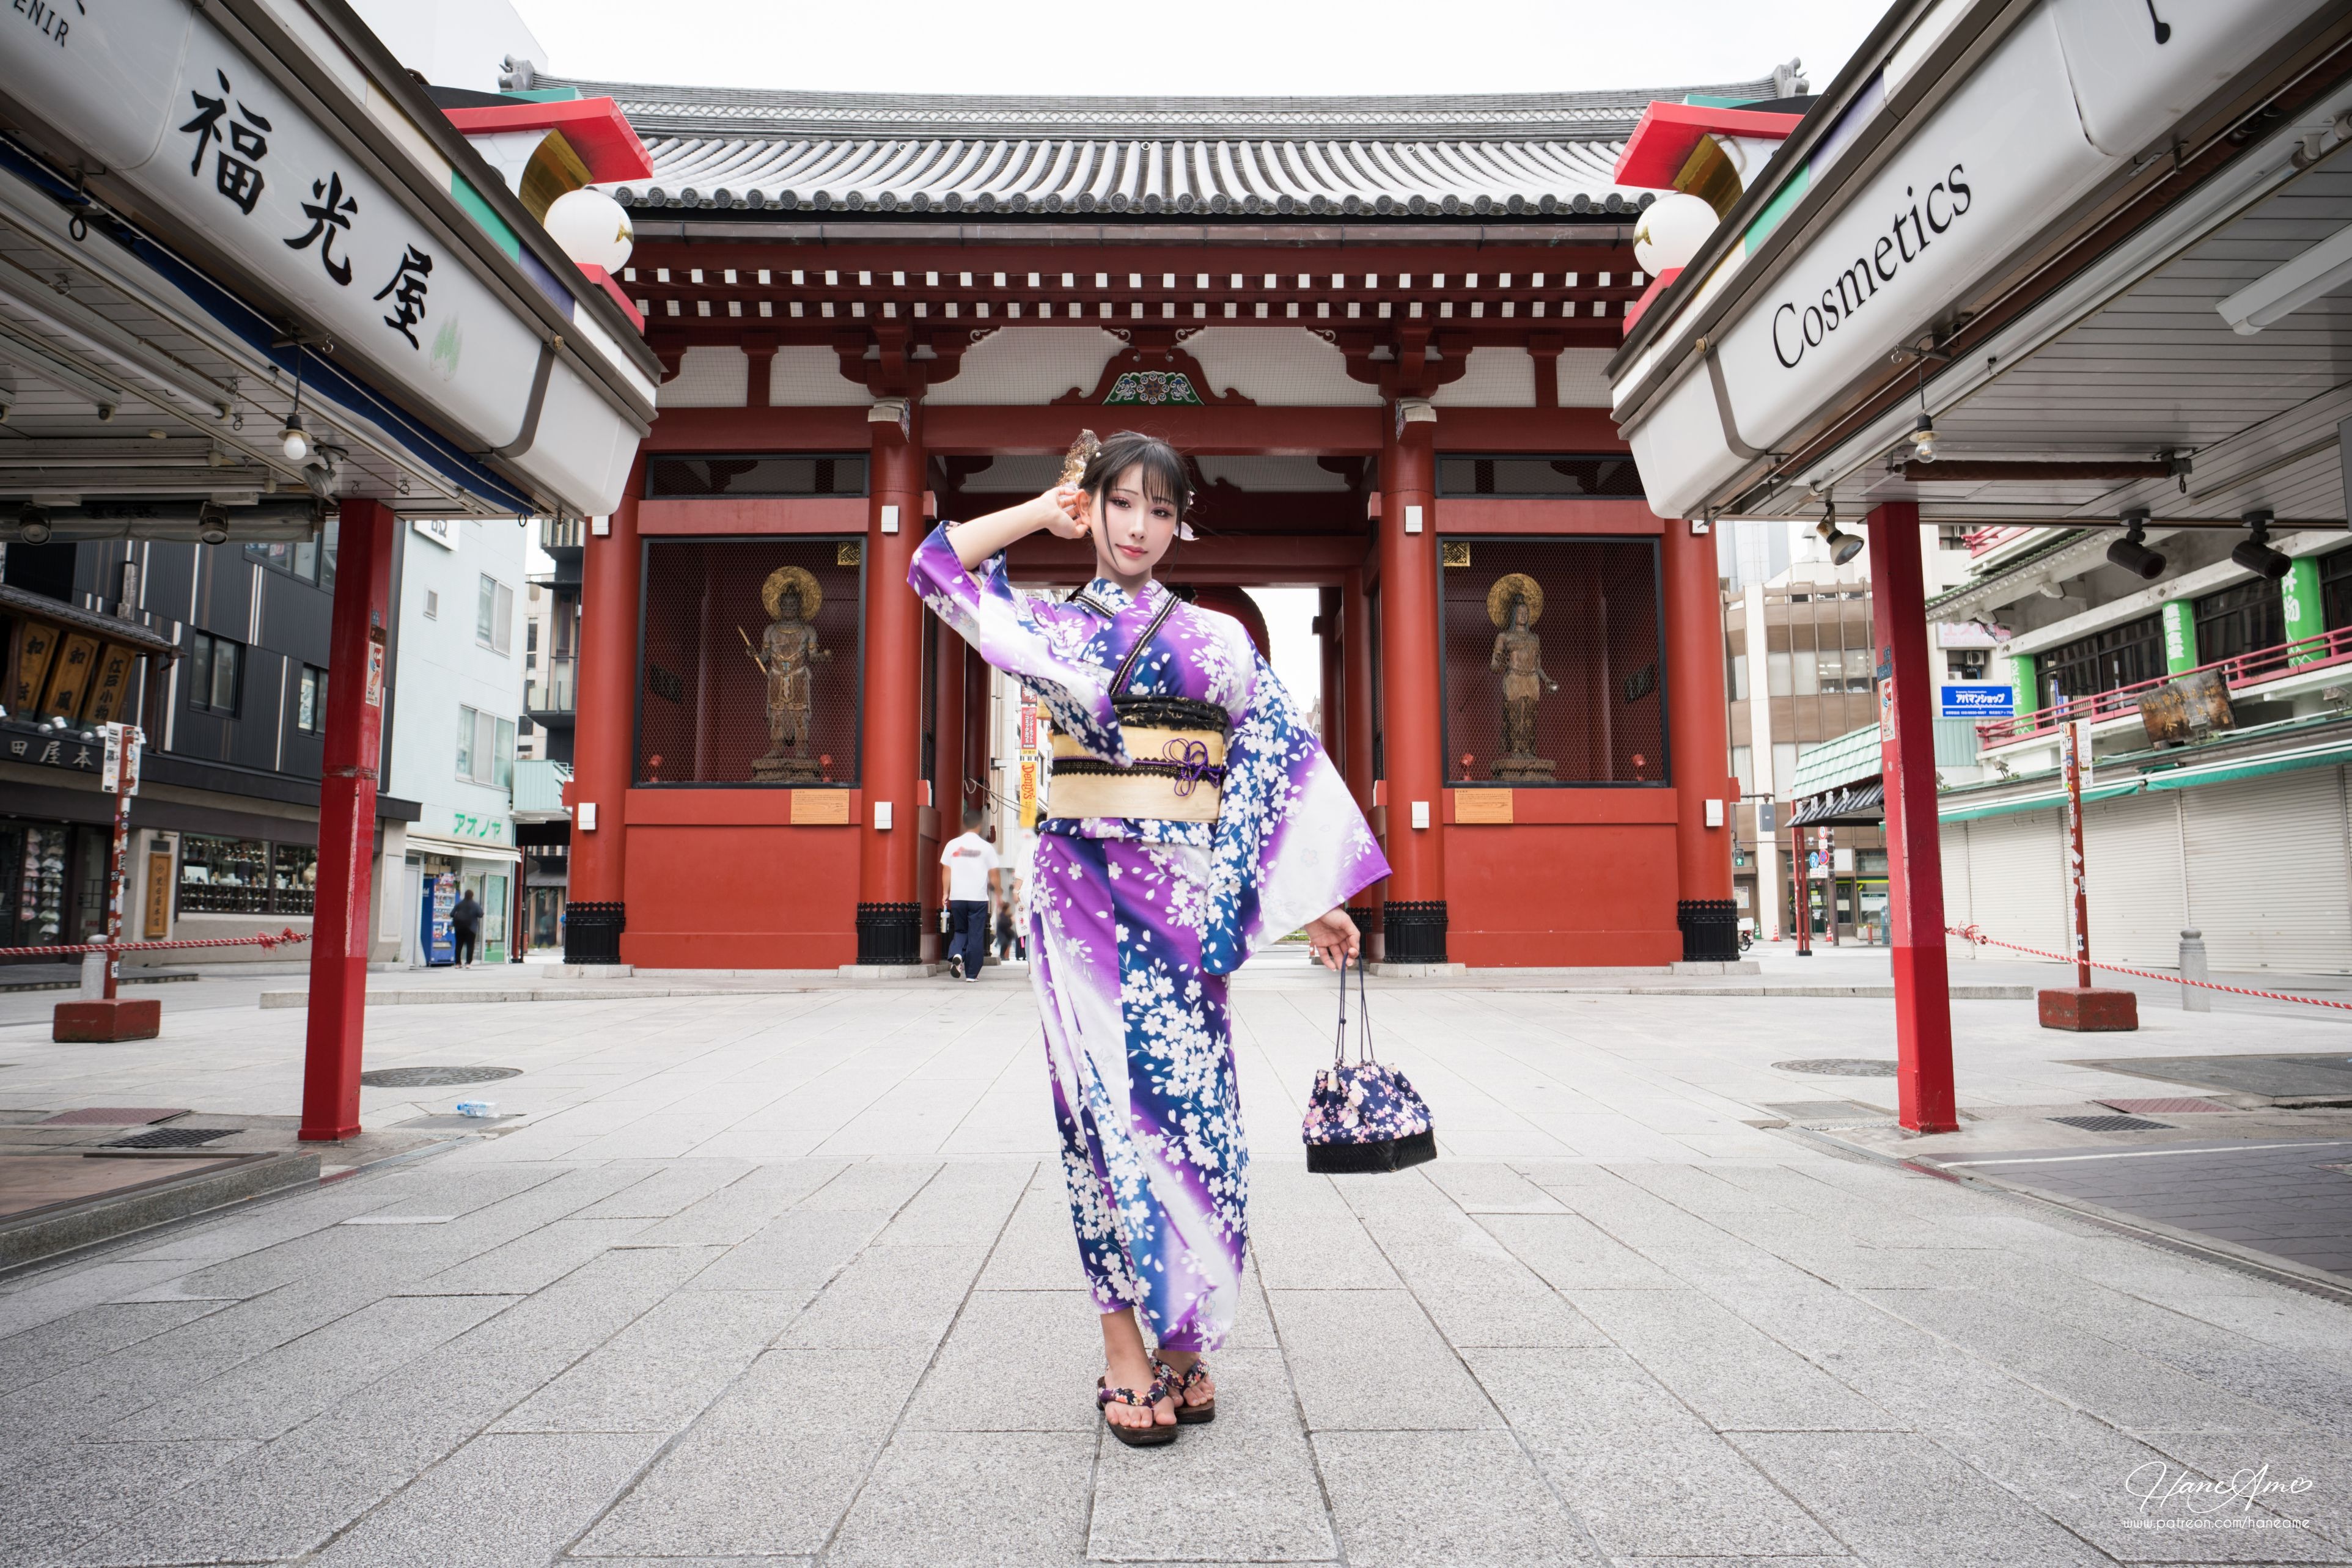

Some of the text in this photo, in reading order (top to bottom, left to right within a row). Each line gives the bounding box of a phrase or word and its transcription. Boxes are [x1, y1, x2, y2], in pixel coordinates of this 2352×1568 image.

[178, 68, 433, 351] 福光屋
[1773, 163, 1971, 368] Cosmetics
[1955, 692, 2005, 705] アパマンショップ
[1021, 763, 1035, 800] Denny's
[454, 813, 502, 840] アオノヤ
